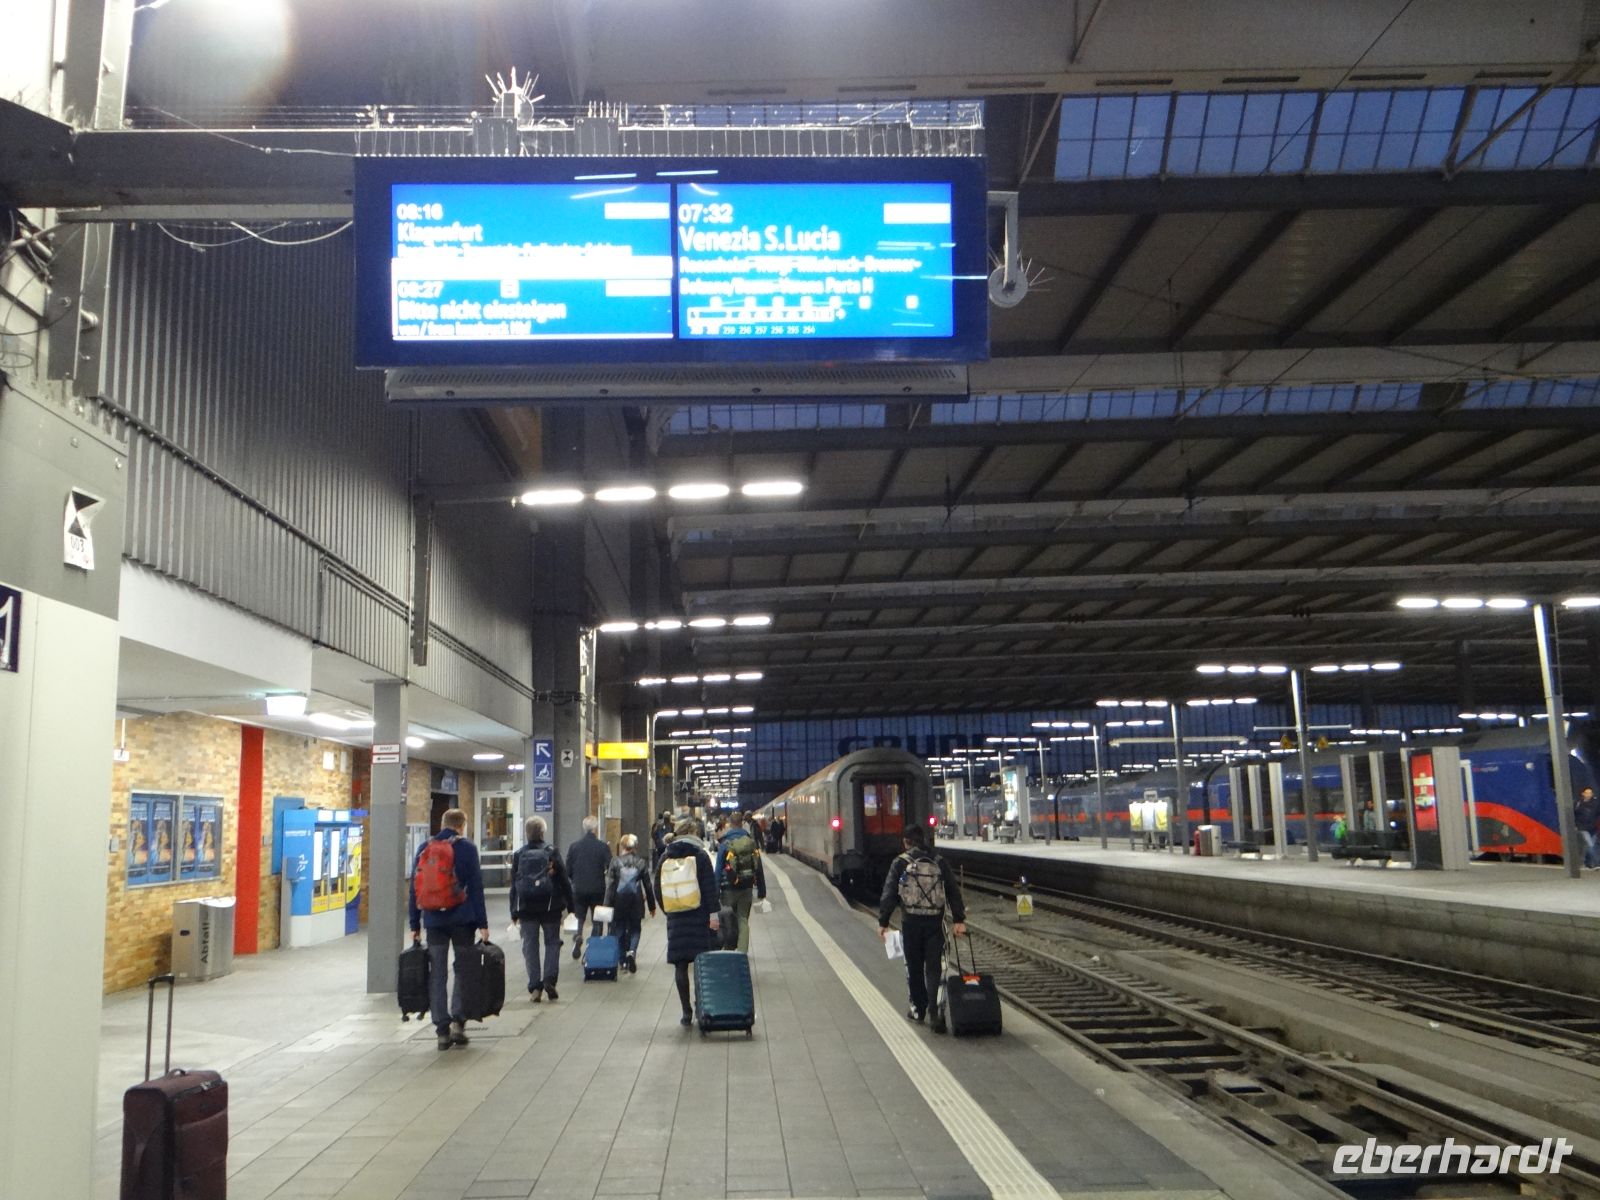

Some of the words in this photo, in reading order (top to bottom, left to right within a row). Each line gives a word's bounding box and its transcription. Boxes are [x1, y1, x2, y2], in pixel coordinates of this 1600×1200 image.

[679, 203, 733, 223] 07:32
[679, 225, 761, 252] Venezia
[440, 299, 481, 319] nicht
[483, 299, 566, 323] einsteigen
[201, 922, 209, 963] Abfall
